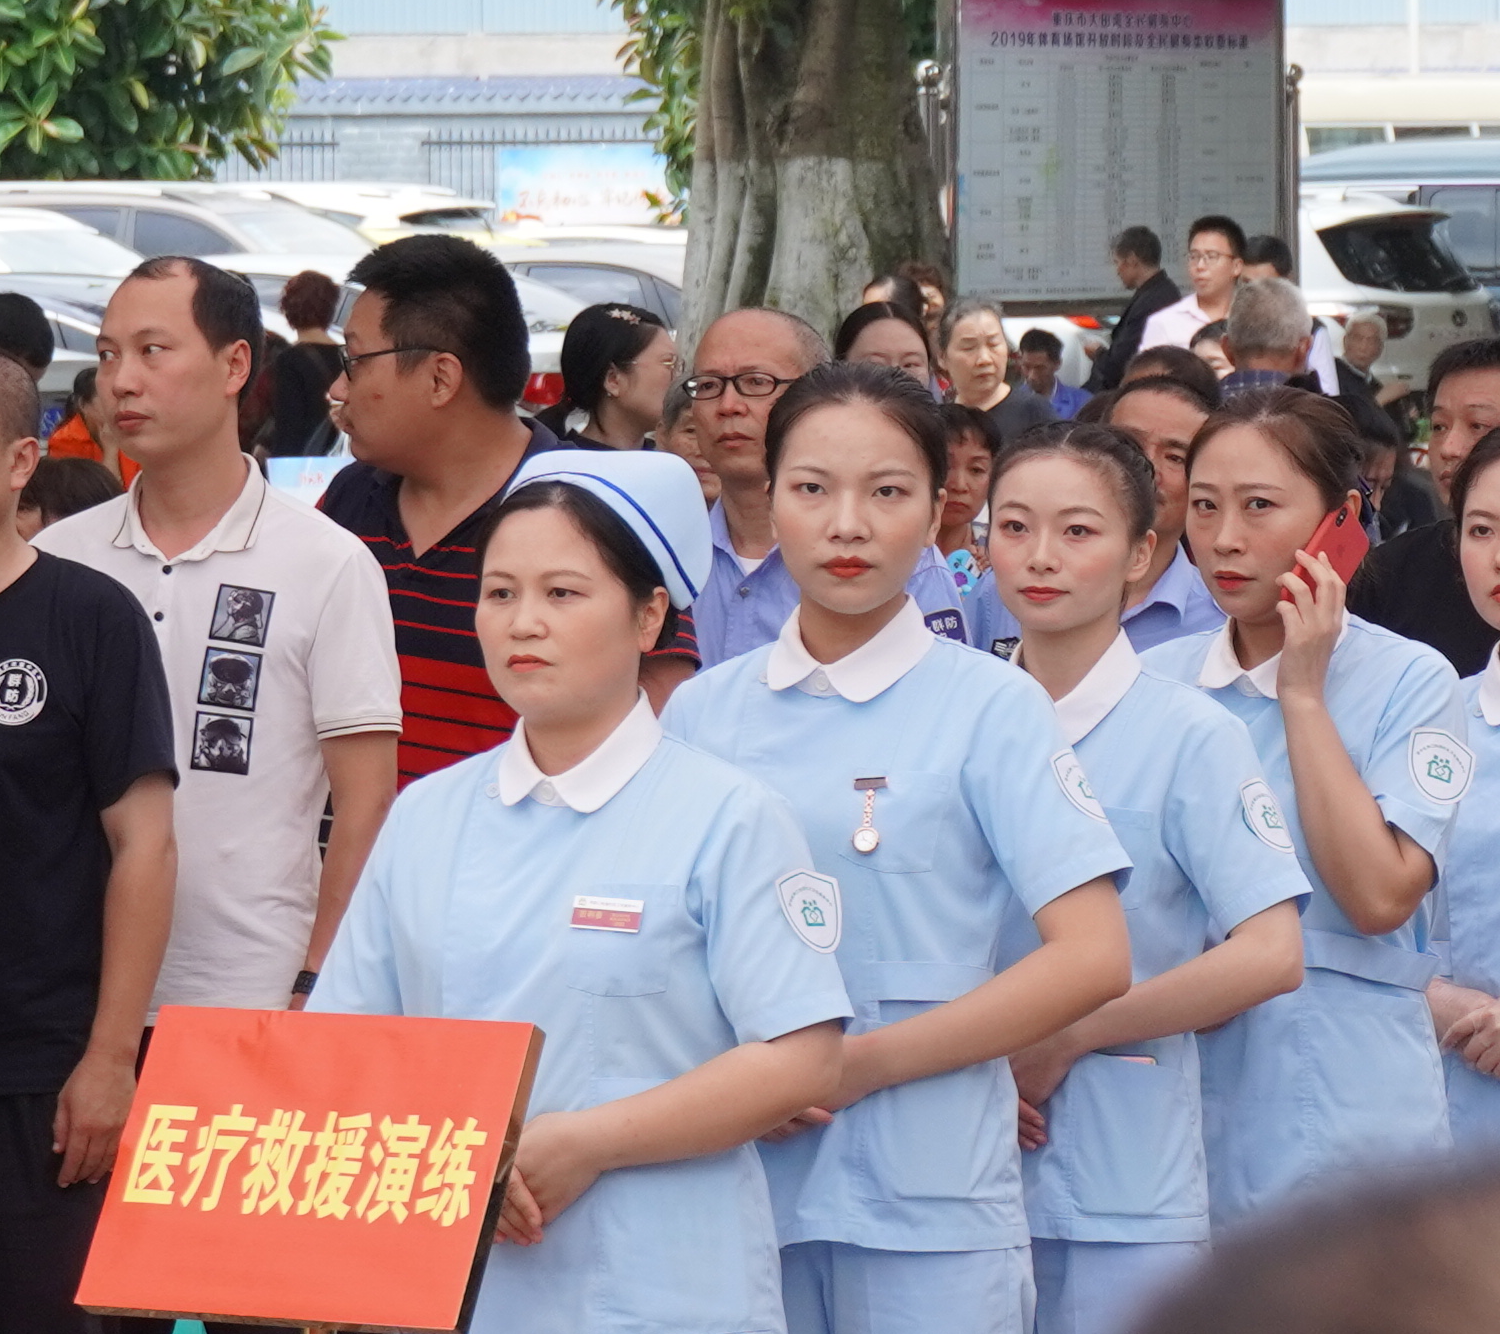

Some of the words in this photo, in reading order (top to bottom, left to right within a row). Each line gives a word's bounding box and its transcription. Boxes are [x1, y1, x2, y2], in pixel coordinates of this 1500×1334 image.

[122, 1103, 488, 1227] 医疗救援演练
